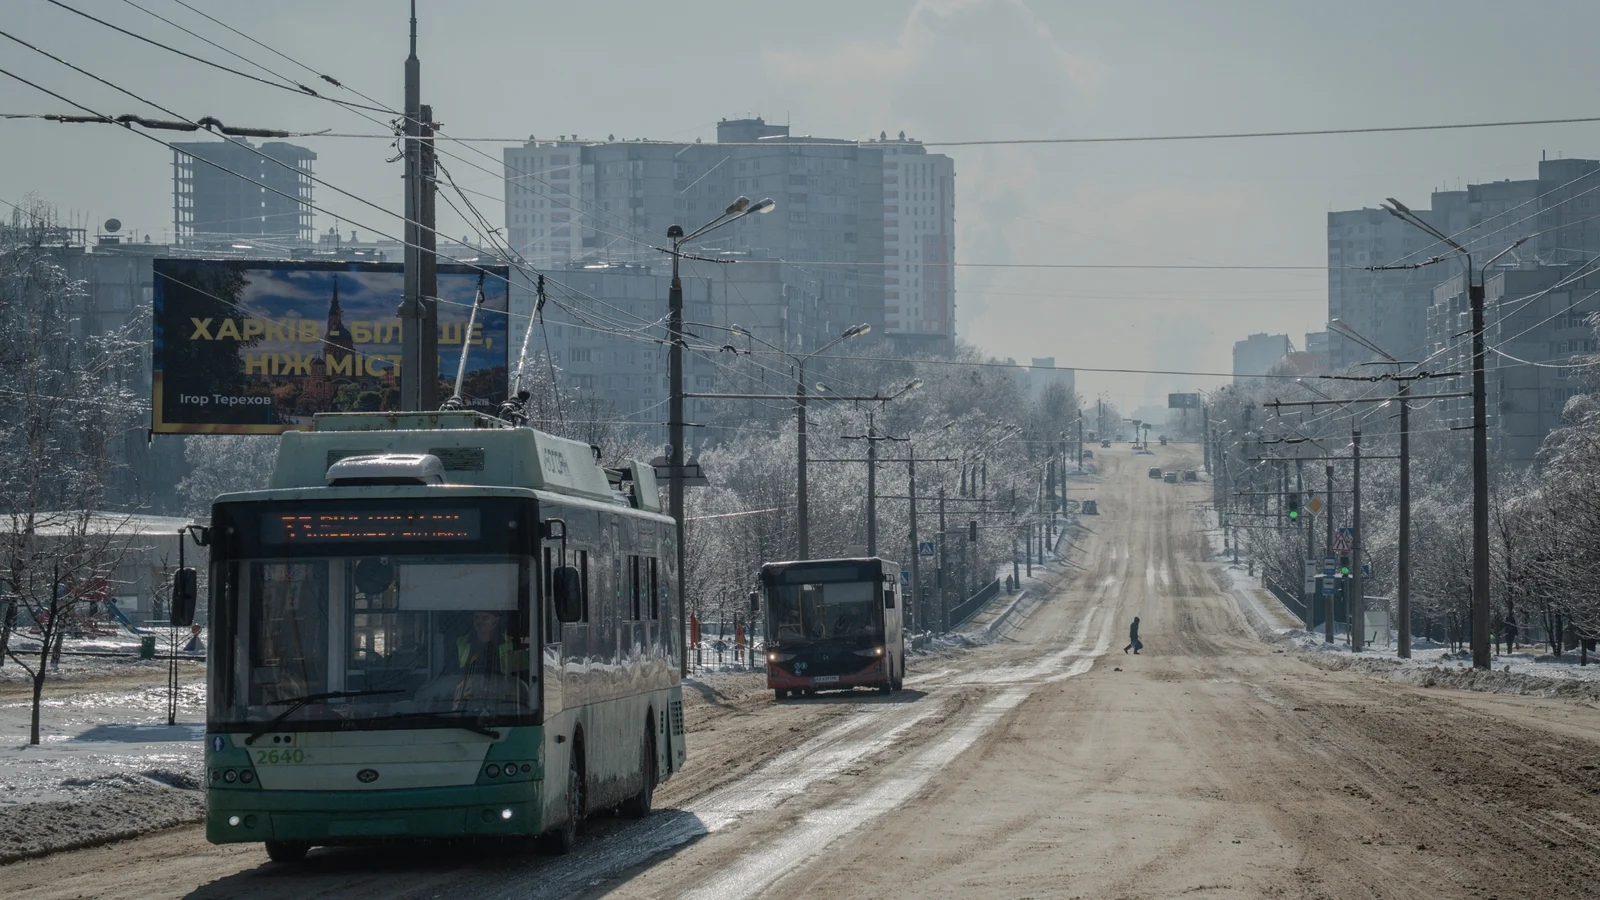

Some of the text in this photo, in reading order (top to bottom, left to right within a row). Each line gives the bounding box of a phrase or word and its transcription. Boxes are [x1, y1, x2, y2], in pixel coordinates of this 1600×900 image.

[190, 317, 320, 343] ХАРКІВ
[351, 320, 493, 350] БІЛШЕ,
[245, 353, 312, 377] НІЖ
[179, 393, 272, 406] Ігор Терехов
[256, 749, 305, 765] 2640
